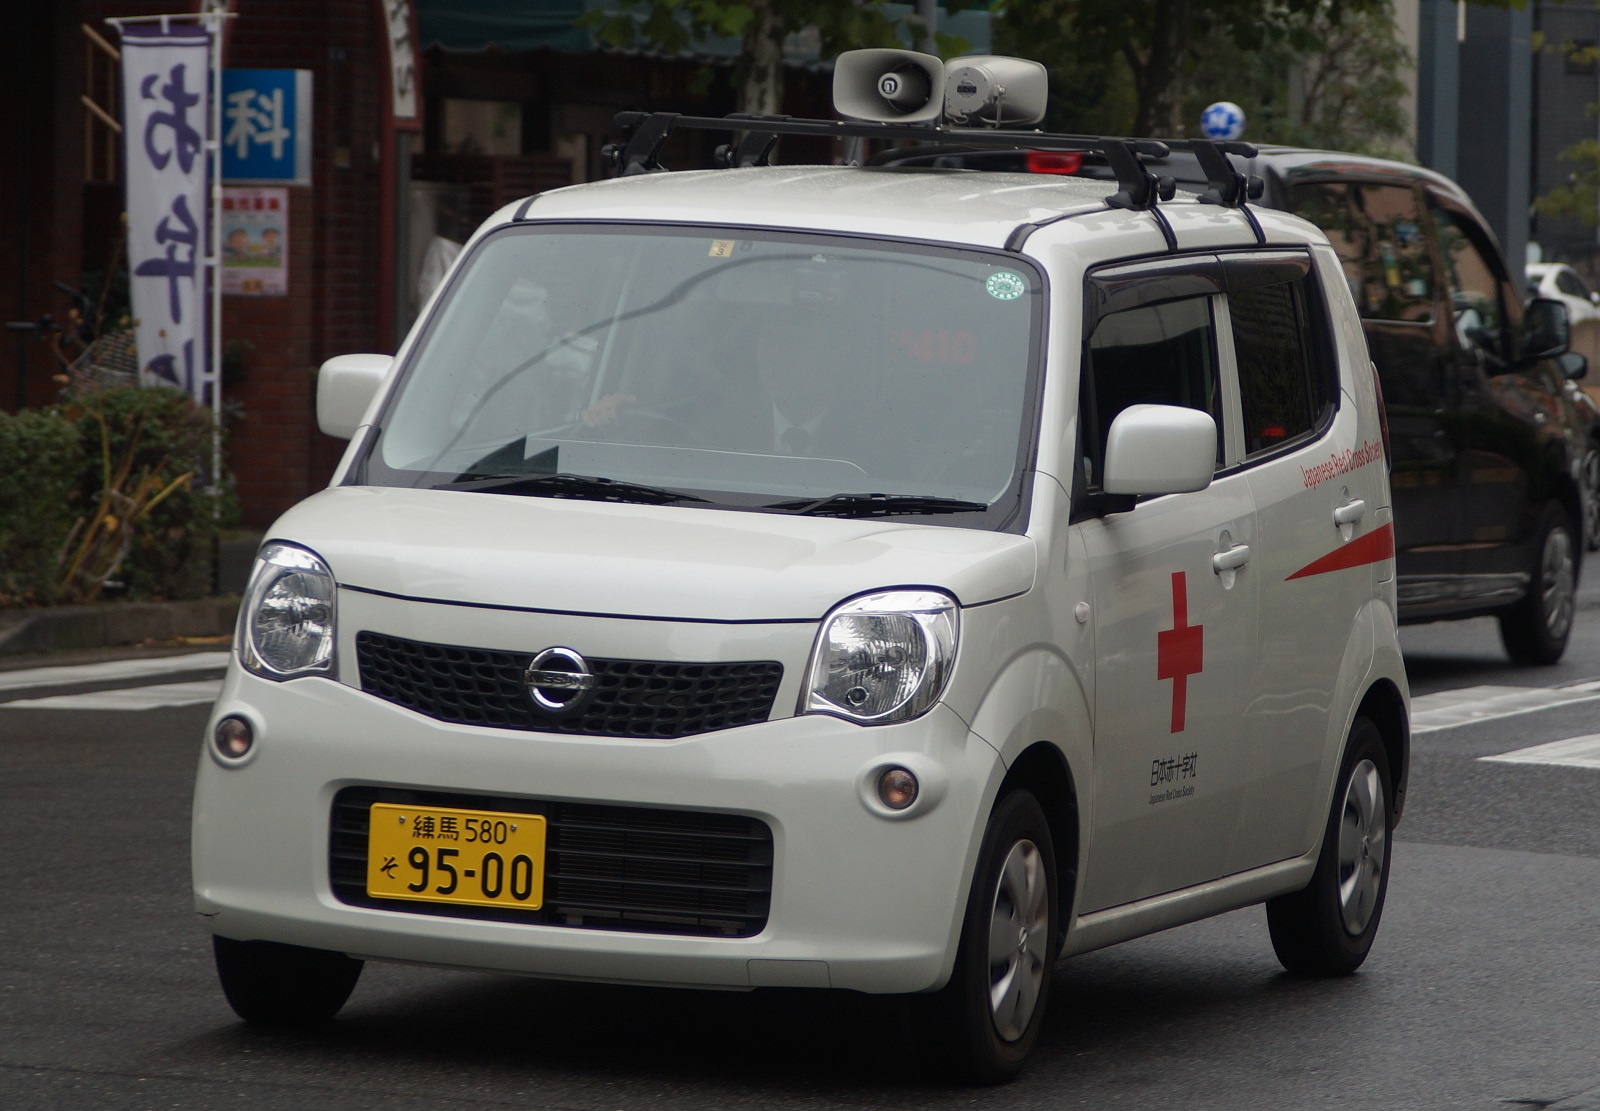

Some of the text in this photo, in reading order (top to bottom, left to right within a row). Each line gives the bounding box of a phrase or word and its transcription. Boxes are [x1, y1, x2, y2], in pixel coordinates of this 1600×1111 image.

[223, 87, 291, 161] 科
[1300, 461, 1335, 490] Japanese
[1331, 451, 1348, 476] Red
[1346, 448, 1366, 471] Cross
[1151, 751, 1197, 786] 日本赤十字社
[412, 815, 508, 845] 練馬 580
[380, 846, 533, 901] そ 95-00
